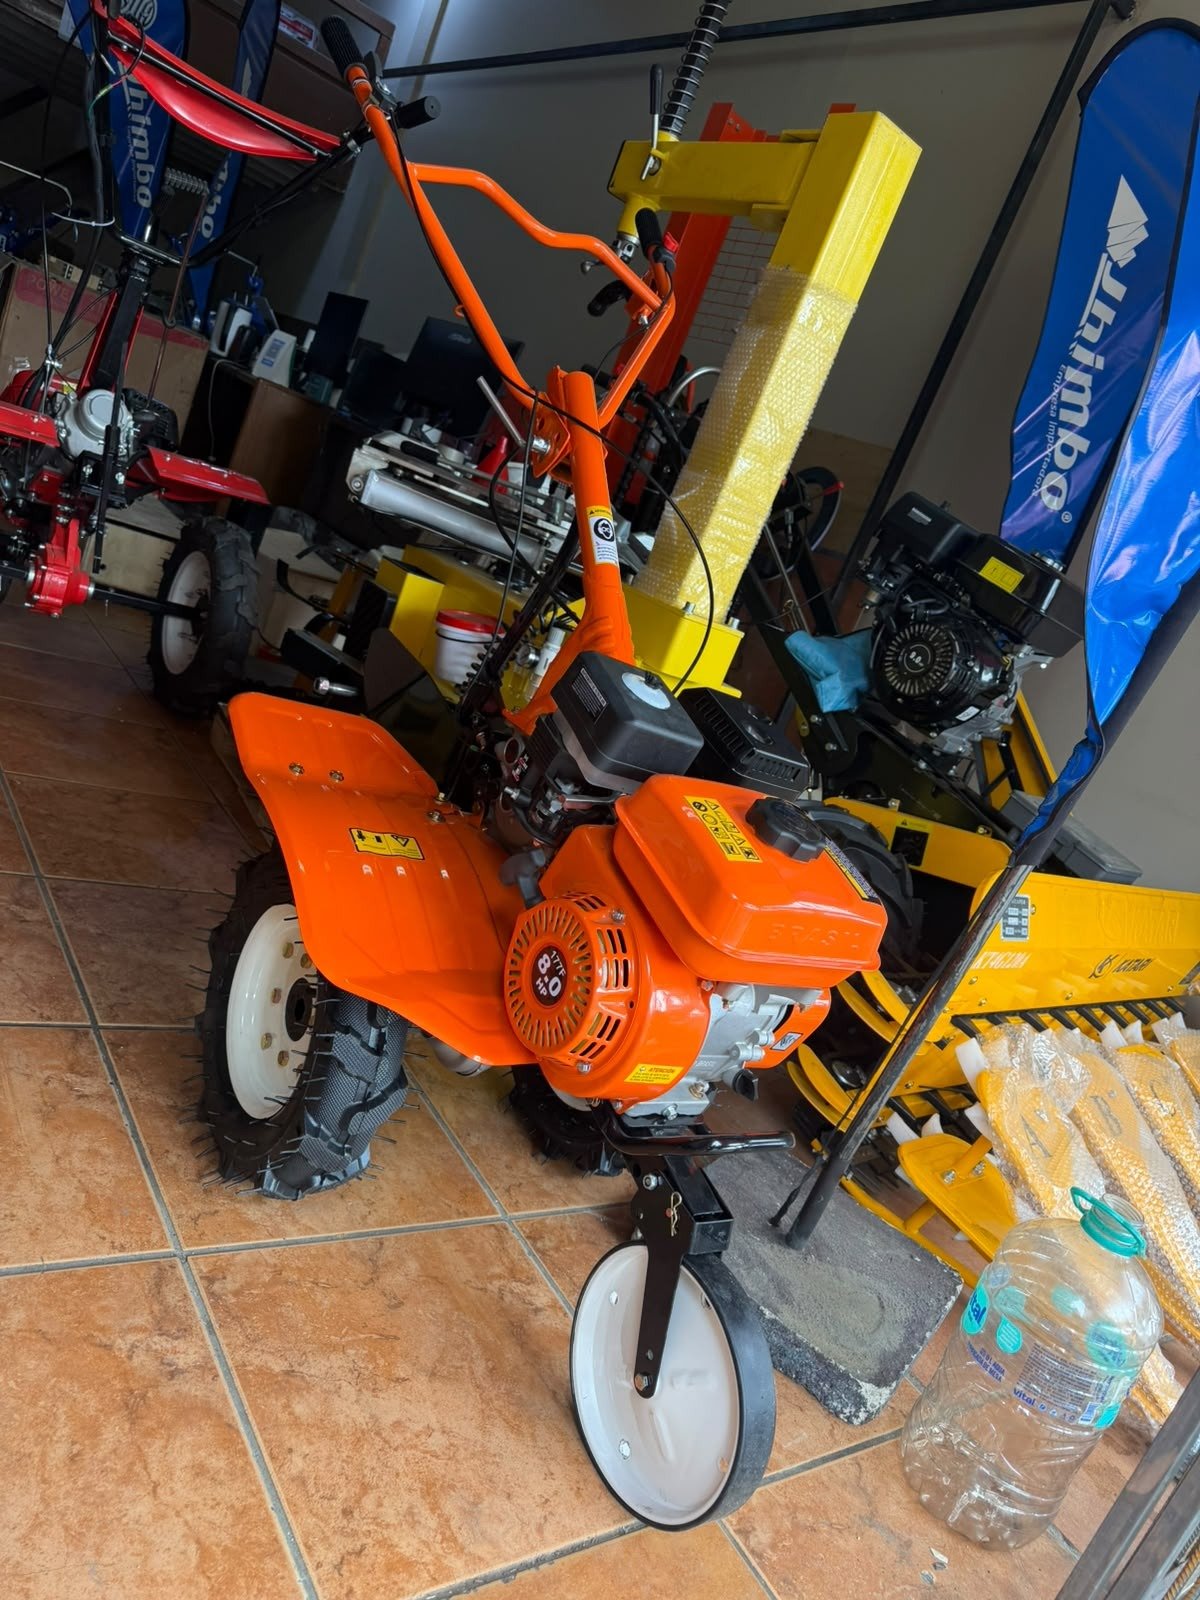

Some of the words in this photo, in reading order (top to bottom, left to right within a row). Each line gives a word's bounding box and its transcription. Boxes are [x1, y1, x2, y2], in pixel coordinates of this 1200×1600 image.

[1041, 256, 1128, 511] Jhimbo
[1049, 364, 1067, 420] Empresa
[1032, 424, 1057, 497] Importadora
[538, 953, 562, 997] 8.0
[551, 950, 567, 976] 177F
[536, 977, 548, 996] HP
[1013, 1387, 1036, 1406] vital
